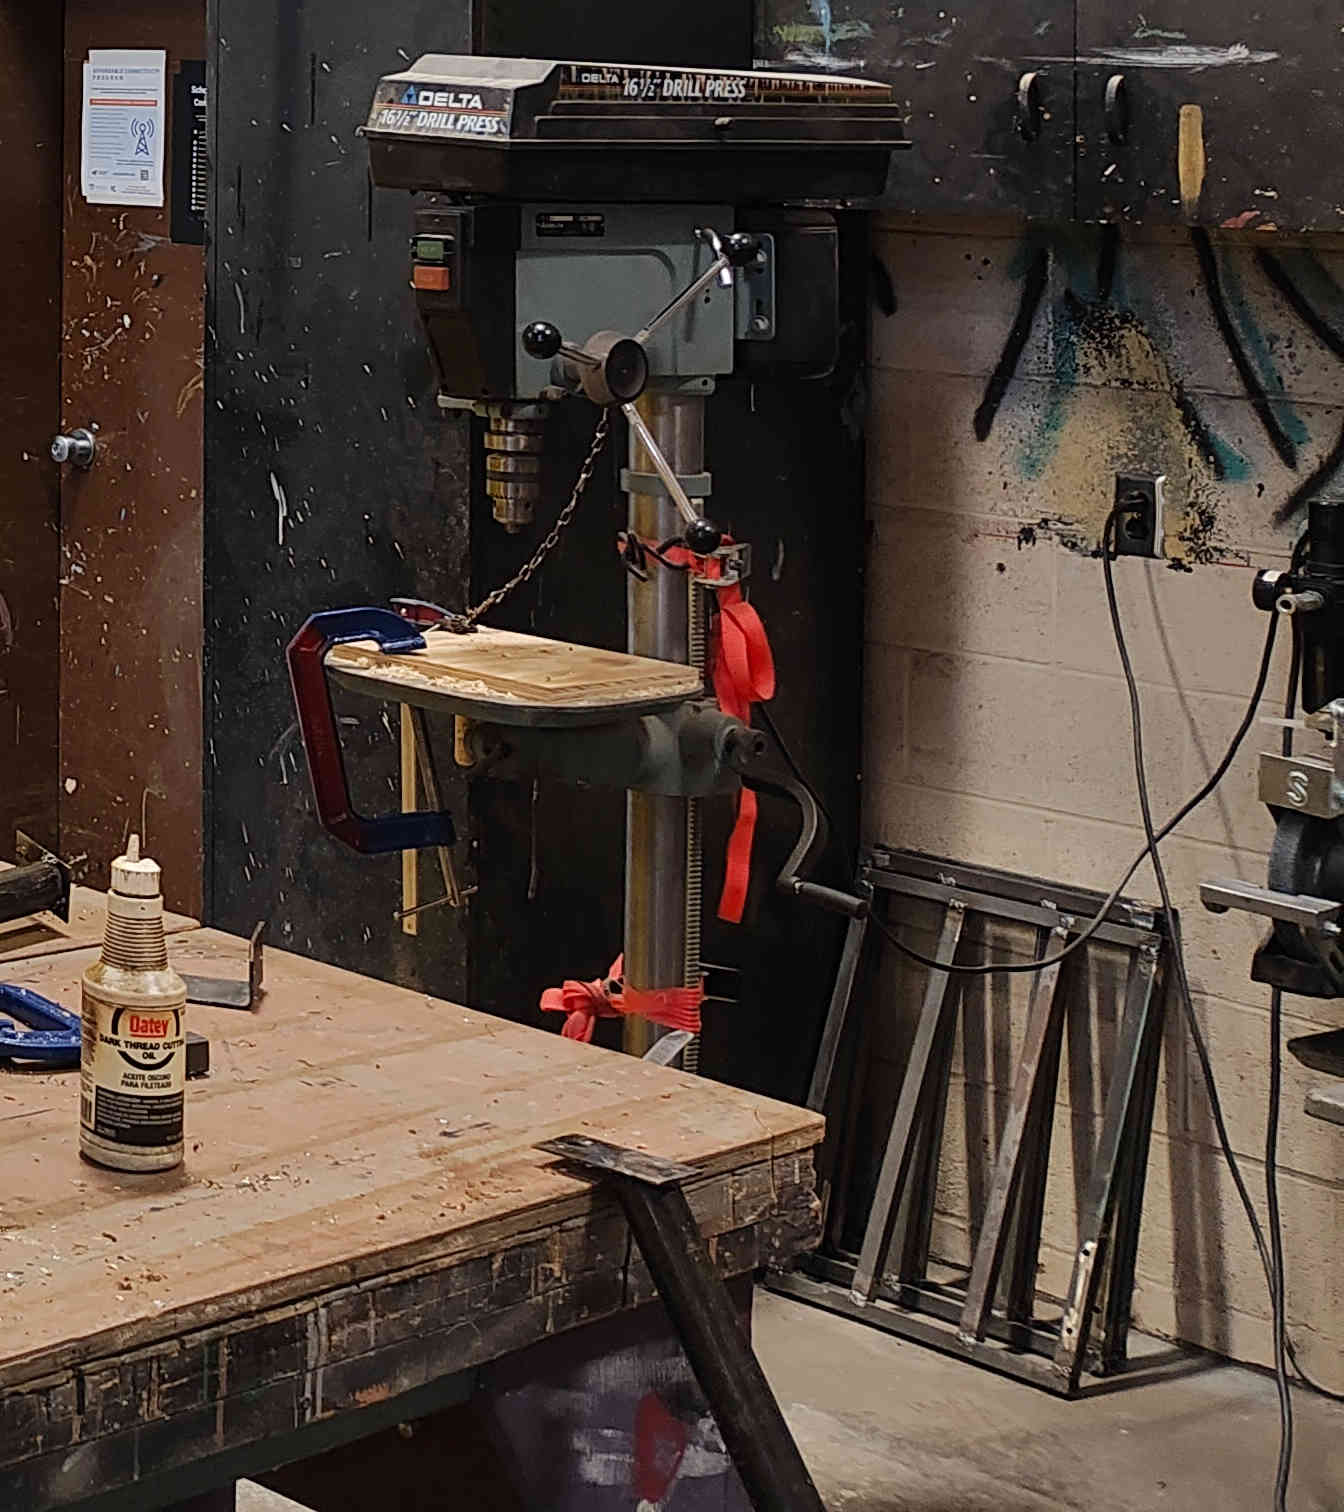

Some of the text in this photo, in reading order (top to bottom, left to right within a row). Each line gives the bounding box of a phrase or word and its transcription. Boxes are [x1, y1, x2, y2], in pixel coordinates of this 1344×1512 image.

[581, 73, 619, 84] DELTA
[663, 79, 703, 97] DRILL
[705, 79, 747, 98] PRESS
[419, 90, 483, 109] DELTA
[417, 112, 456, 129] DRILL
[456, 115, 501, 133] PRESS
[99, 1034, 122, 1048] DARK
[124, 1040, 160, 1050] THREAD
